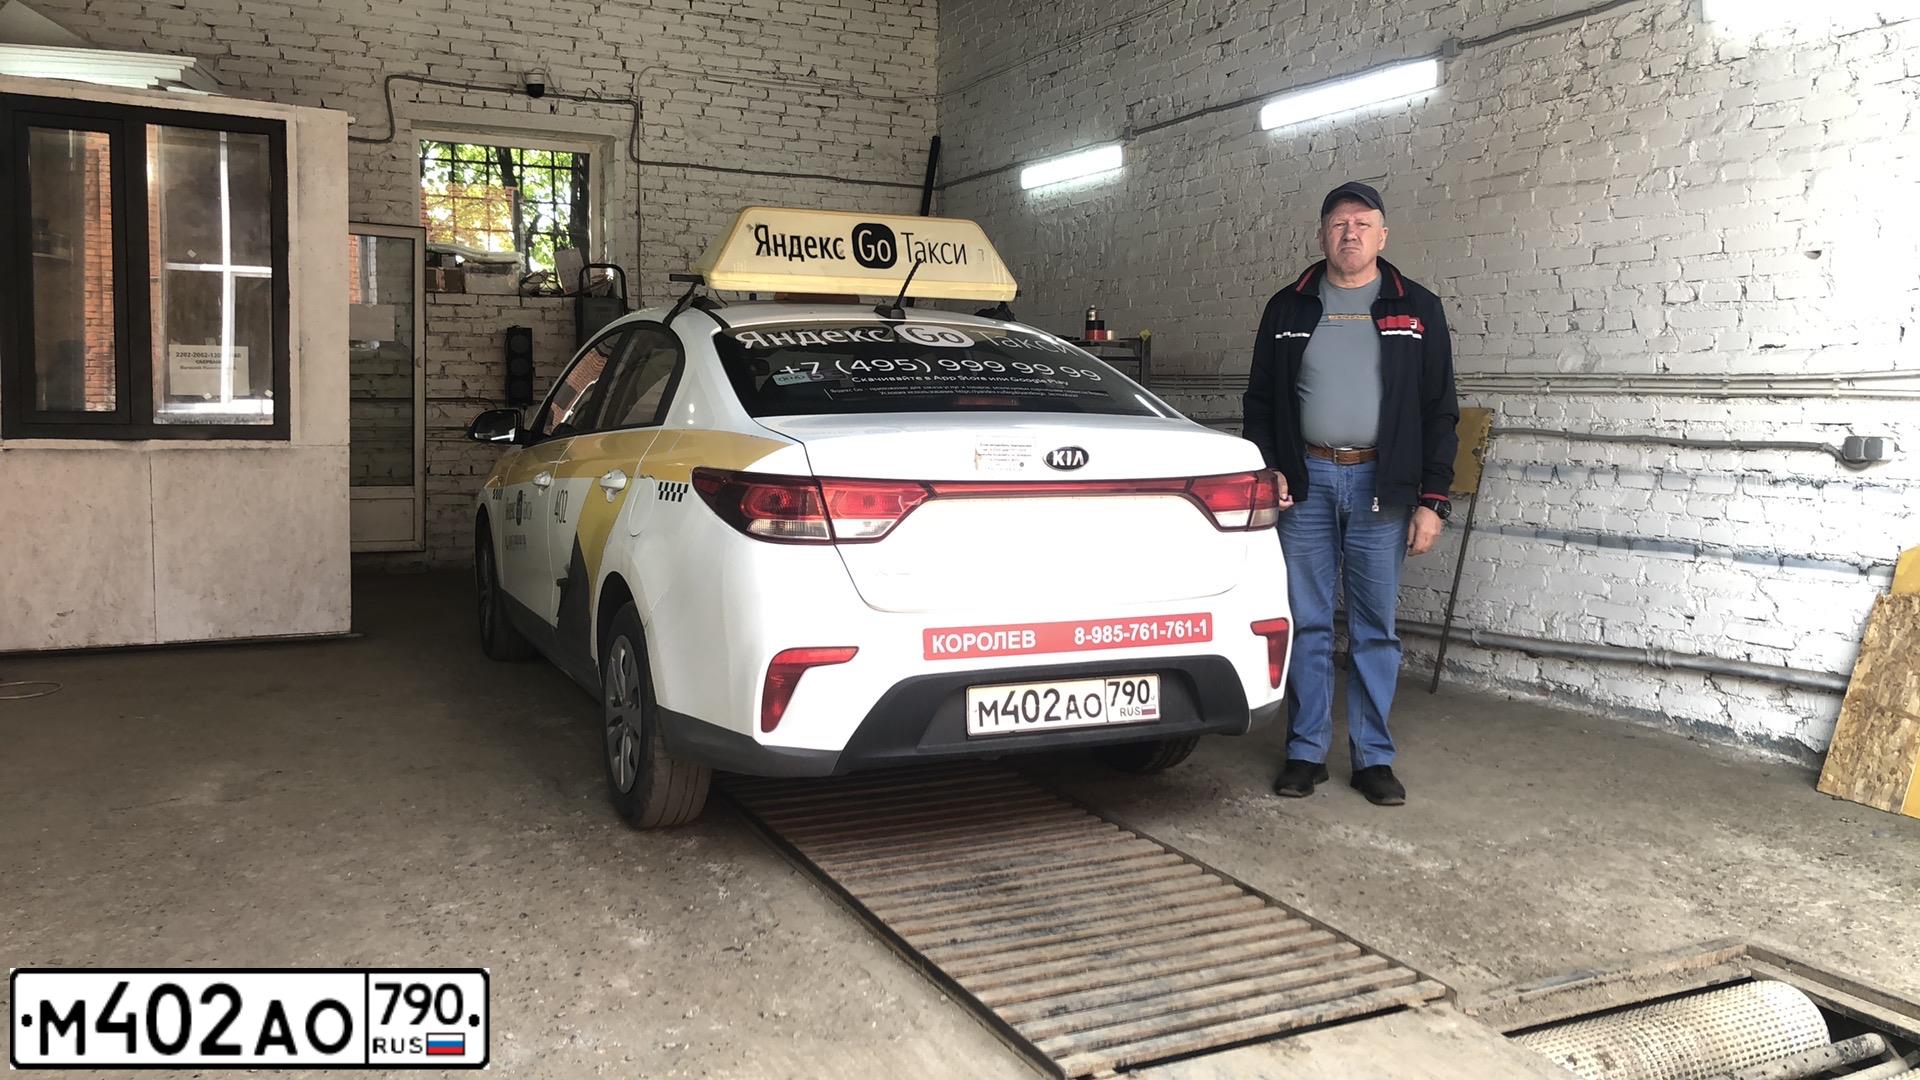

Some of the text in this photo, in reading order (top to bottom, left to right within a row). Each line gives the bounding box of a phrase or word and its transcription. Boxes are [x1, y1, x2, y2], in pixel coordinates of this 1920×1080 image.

[754, 223, 968, 265] Яндекс Go Такси
[735, 327, 1080, 357] Яндекс Go Такси
[780, 358, 1102, 382] +7 (495) 999 99 99
[851, 375, 922, 383] Скачивайте
[1010, 376, 1047, 384] Google
[1047, 378, 1069, 386] Play
[1052, 450, 1084, 466] KIA
[554, 489, 568, 523] 402
[932, 619, 1207, 653] КОРОЛЕВ 8-985-761-761-1
[1107, 679, 1151, 707] 790
[1120, 706, 1141, 717] RUS
